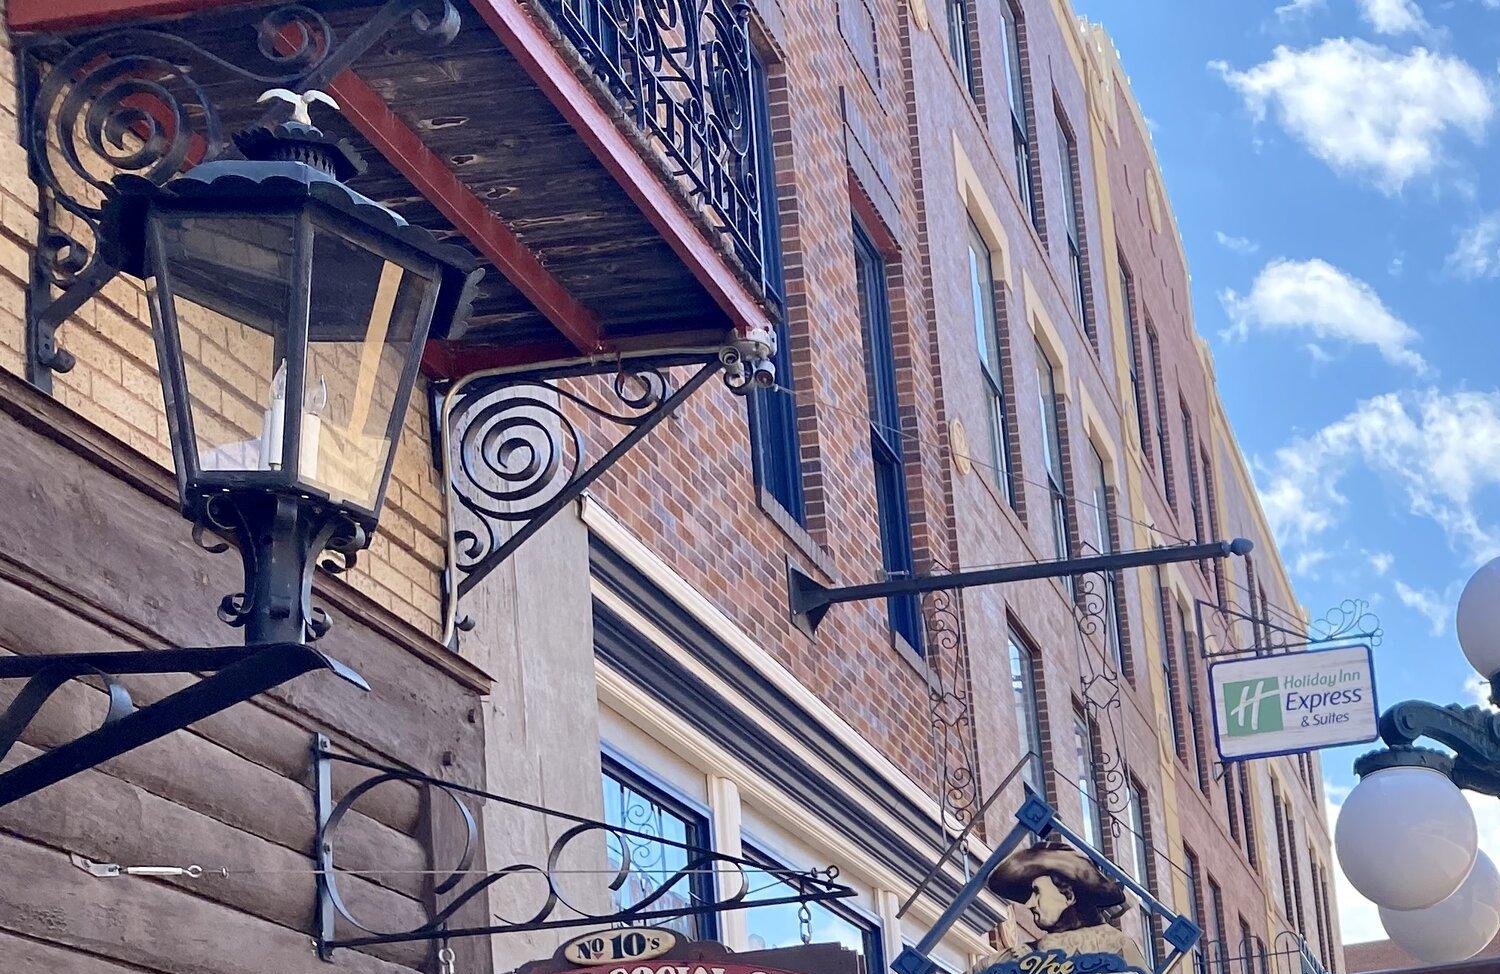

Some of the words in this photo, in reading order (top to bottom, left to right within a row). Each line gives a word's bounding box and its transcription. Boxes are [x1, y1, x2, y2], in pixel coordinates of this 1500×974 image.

[1284, 671, 1337, 689] Holiday
[1339, 668, 1361, 683] Inn
[1286, 687, 1362, 713] Express
[1301, 715, 1310, 727] &
[1313, 712, 1350, 726] Suites
